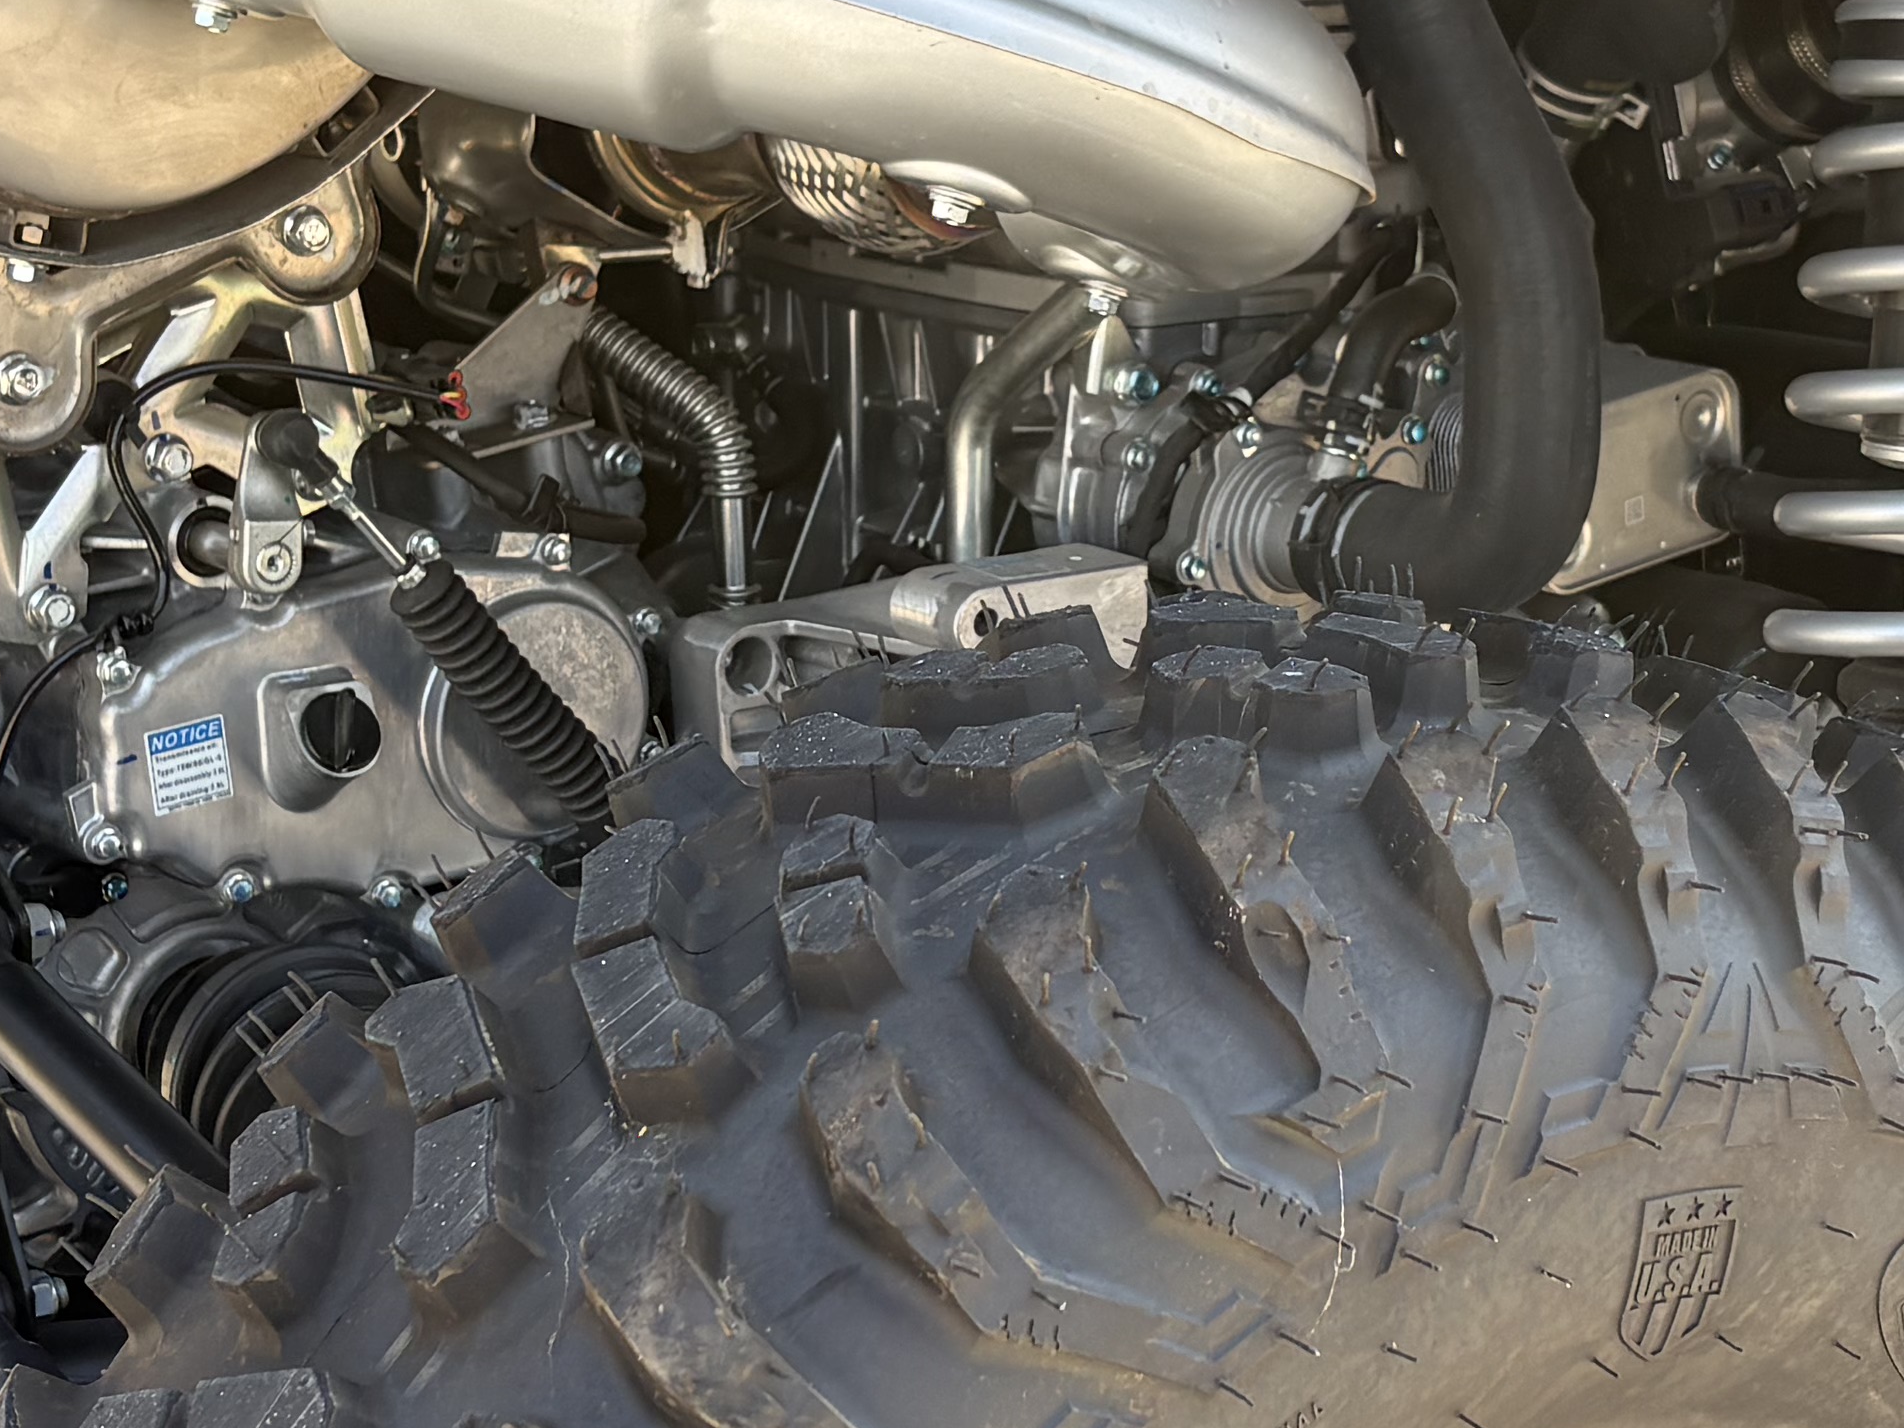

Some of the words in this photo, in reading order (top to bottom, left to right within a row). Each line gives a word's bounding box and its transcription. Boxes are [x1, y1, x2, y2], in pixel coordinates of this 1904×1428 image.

[150, 720, 221, 754] NOTICE
[1654, 1227, 1703, 1258] MADE
[1702, 1223, 1719, 1250] IN
[1634, 1250, 1722, 1305] U.S.A.
